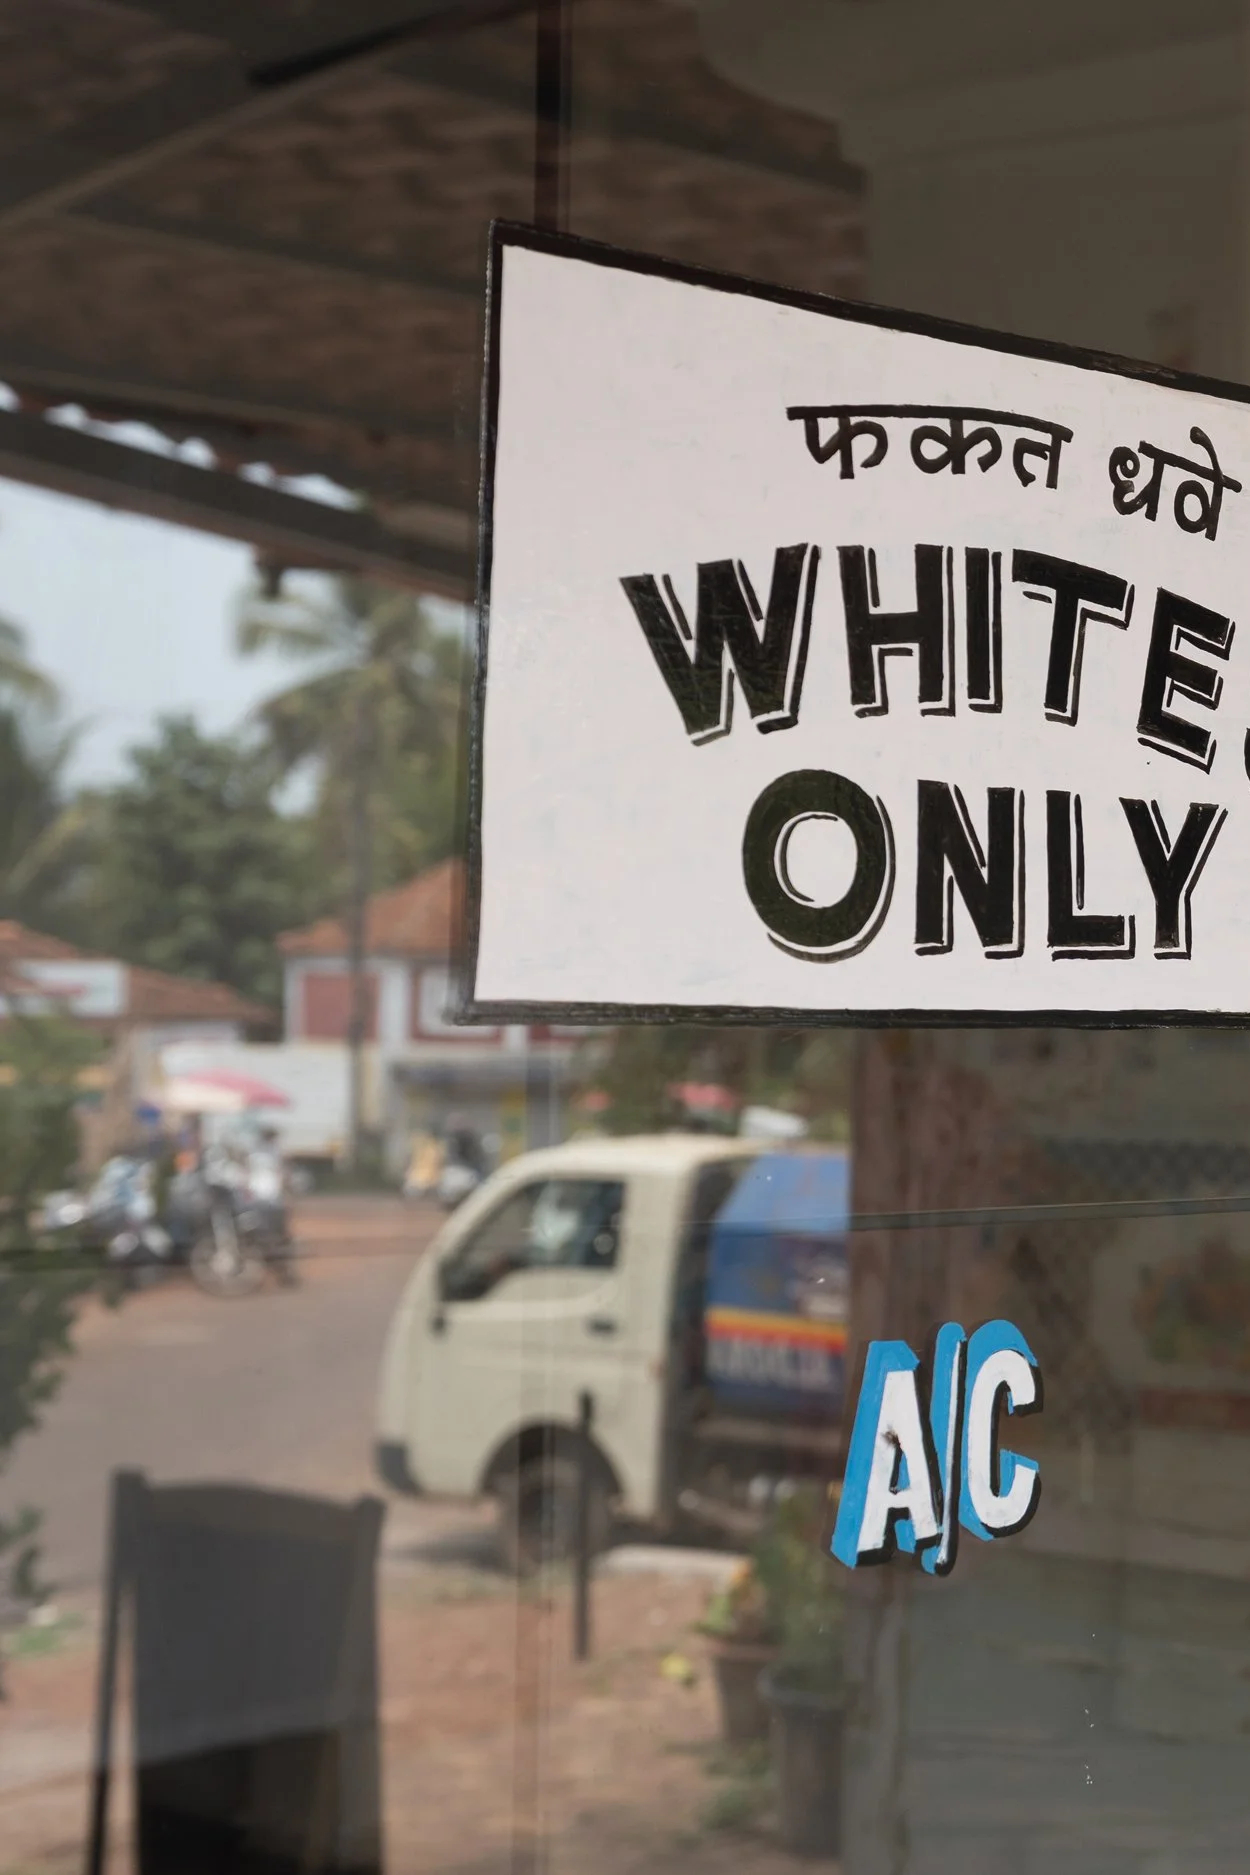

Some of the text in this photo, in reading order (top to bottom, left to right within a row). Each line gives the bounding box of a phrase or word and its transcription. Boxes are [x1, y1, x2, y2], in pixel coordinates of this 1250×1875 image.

[787, 404, 1243, 542] फकत धवे
[743, 769, 1229, 962] ONLY
[830, 1319, 1044, 1577] A/C
